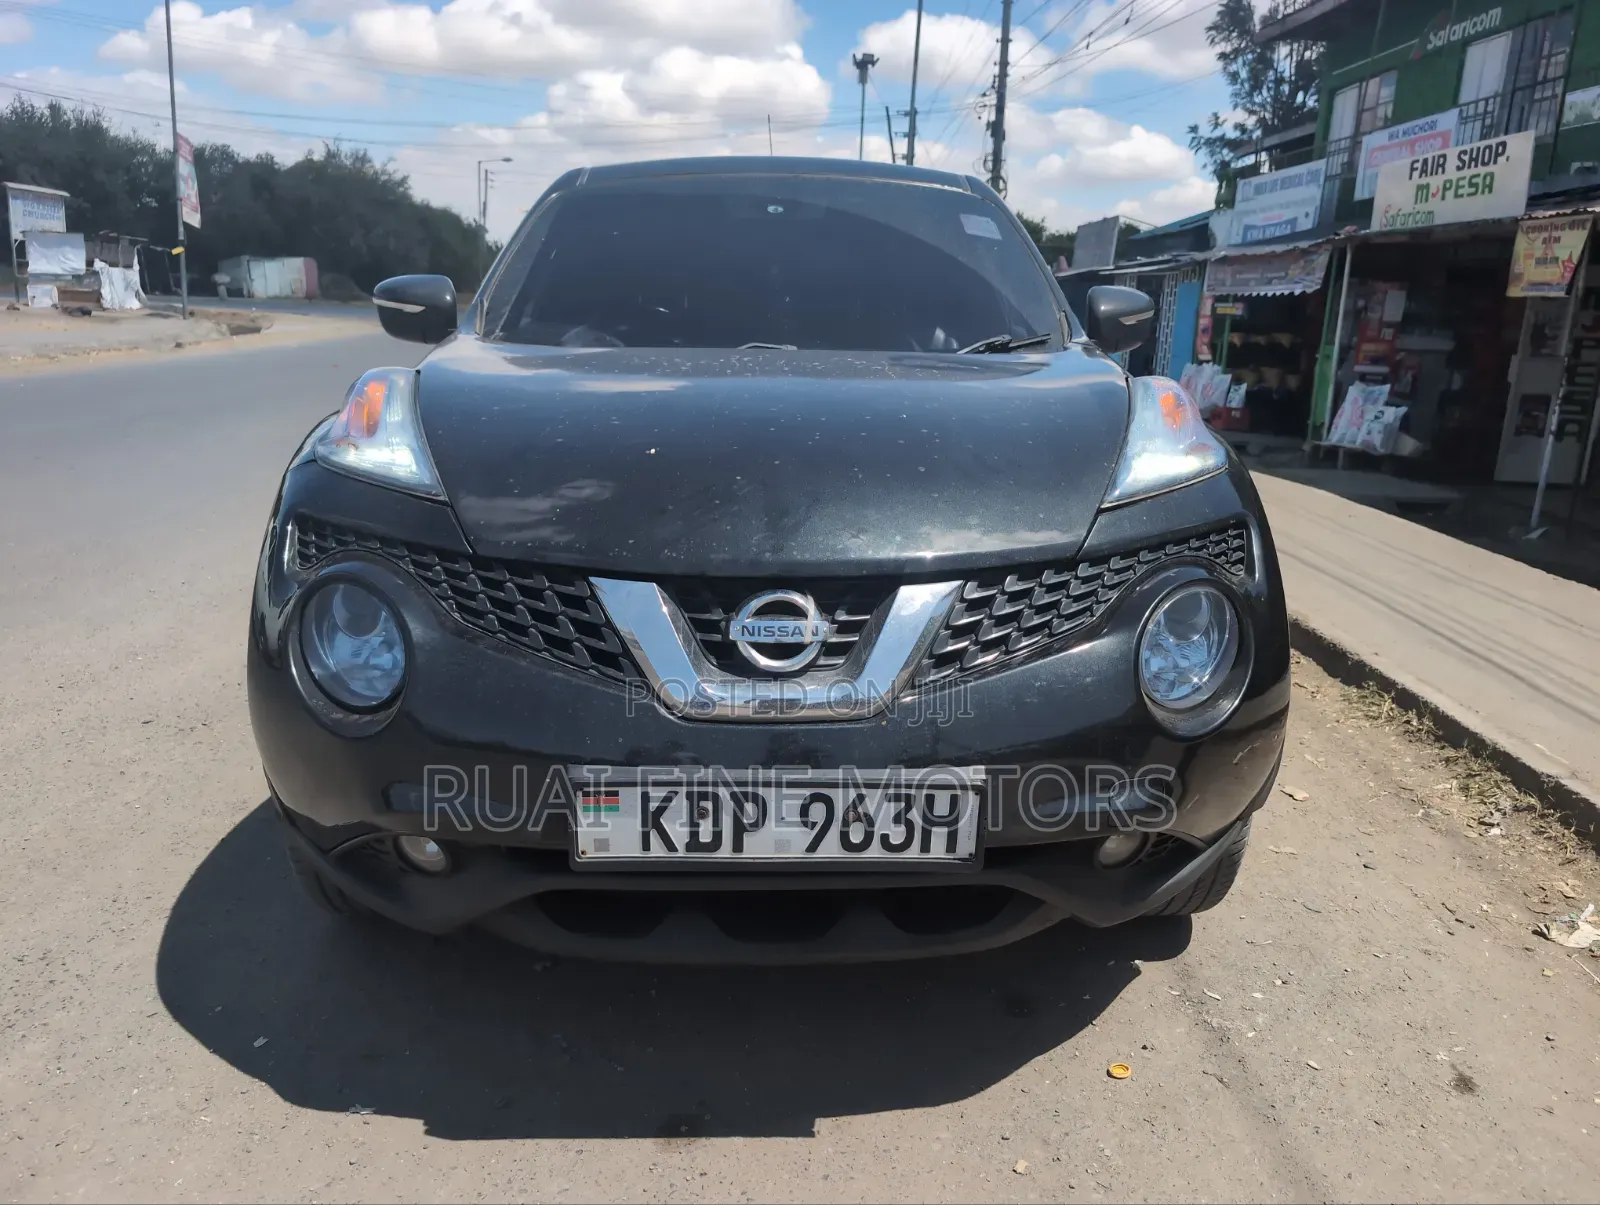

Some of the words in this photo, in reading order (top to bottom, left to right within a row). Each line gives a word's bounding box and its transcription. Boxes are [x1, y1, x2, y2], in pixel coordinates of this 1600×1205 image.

[1408, 153, 1448, 181] FAIR
[1383, 206, 1435, 228] Safaricom
[741, 625, 819, 637] NISSAN
[640, 790, 768, 853] KDP
[799, 791, 961, 854] 963H
